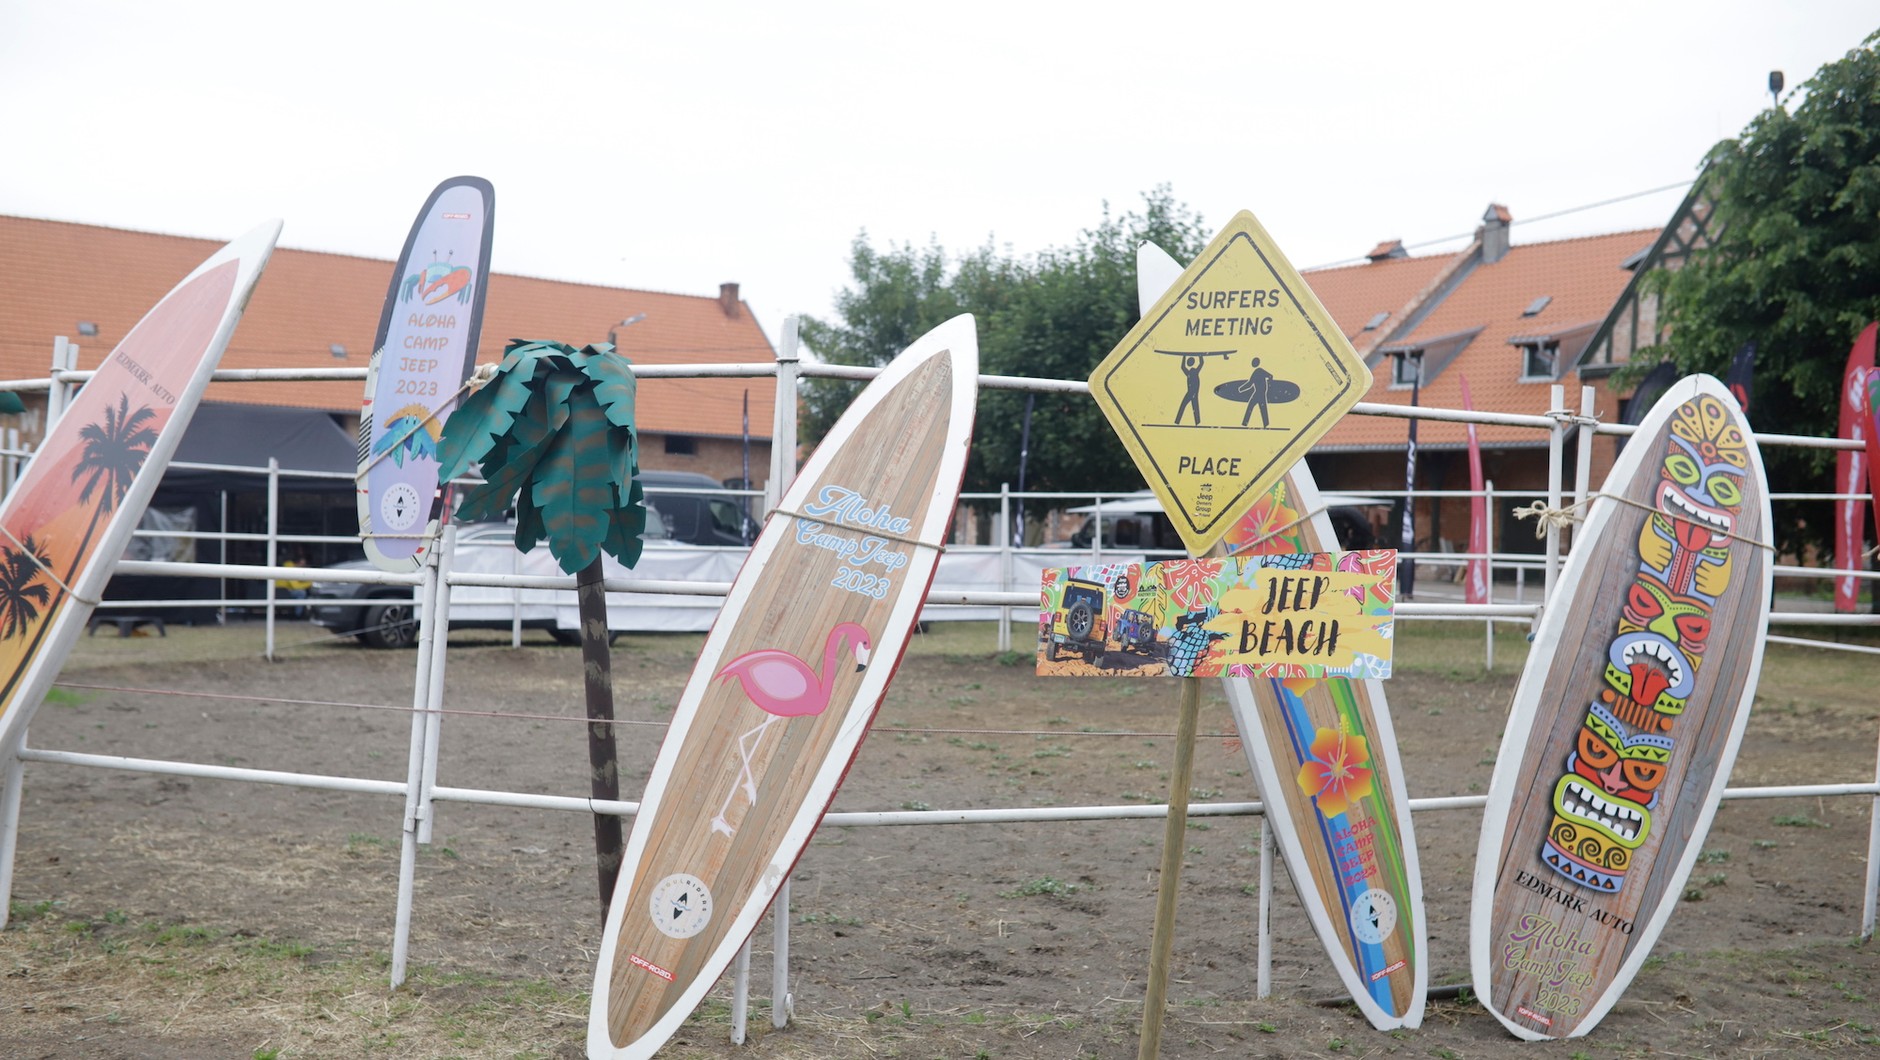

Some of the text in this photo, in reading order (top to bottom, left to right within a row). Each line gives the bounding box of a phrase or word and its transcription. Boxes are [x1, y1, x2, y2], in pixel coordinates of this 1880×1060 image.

[1186, 289, 1280, 310] SURFERS
[1185, 317, 1273, 336] MEETING
[403, 335, 449, 351] CAMP
[116, 351, 176, 405] EDMARK AUTO
[399, 357, 438, 373] JEEP
[394, 379, 438, 396] 2023
[1178, 456, 1242, 476] PLACE
[804, 484, 911, 535] Aloha
[1197, 493, 1213, 501] Jeep
[796, 517, 858, 559] Camp
[848, 535, 907, 573] Jeep
[831, 566, 891, 600] 2023
[1261, 576, 1330, 615] JEEP
[1239, 618, 1341, 657] BEACH
[1334, 816, 1376, 843] ALOHA
[1337, 832, 1375, 857] CAMP
[1516, 870, 1635, 936] EDMARK AUTO
[1509, 913, 1596, 956] Aloha
[1503, 943, 1595, 991] Camp Jeep
[1535, 988, 1583, 1017] 2023
